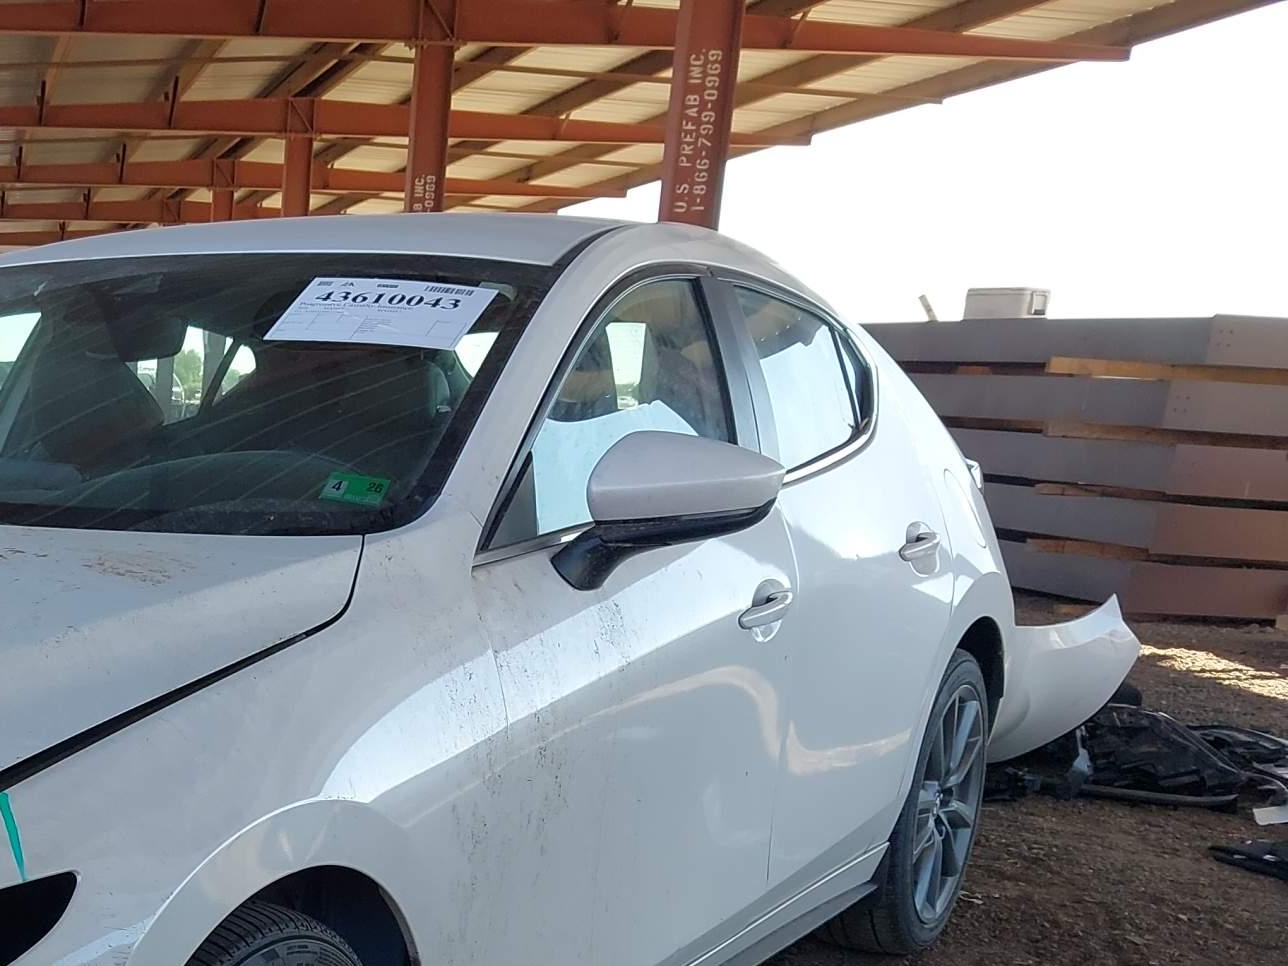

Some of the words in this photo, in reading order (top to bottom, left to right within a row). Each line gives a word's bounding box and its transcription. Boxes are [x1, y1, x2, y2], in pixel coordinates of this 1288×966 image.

[678, 94, 700, 167] PREFAB
[689, 48, 706, 84] INC.
[690, 49, 723, 211] 1-866-799-0969
[314, 290, 462, 310] 43610043
[331, 480, 344, 491] 4
[365, 482, 384, 494] 26
